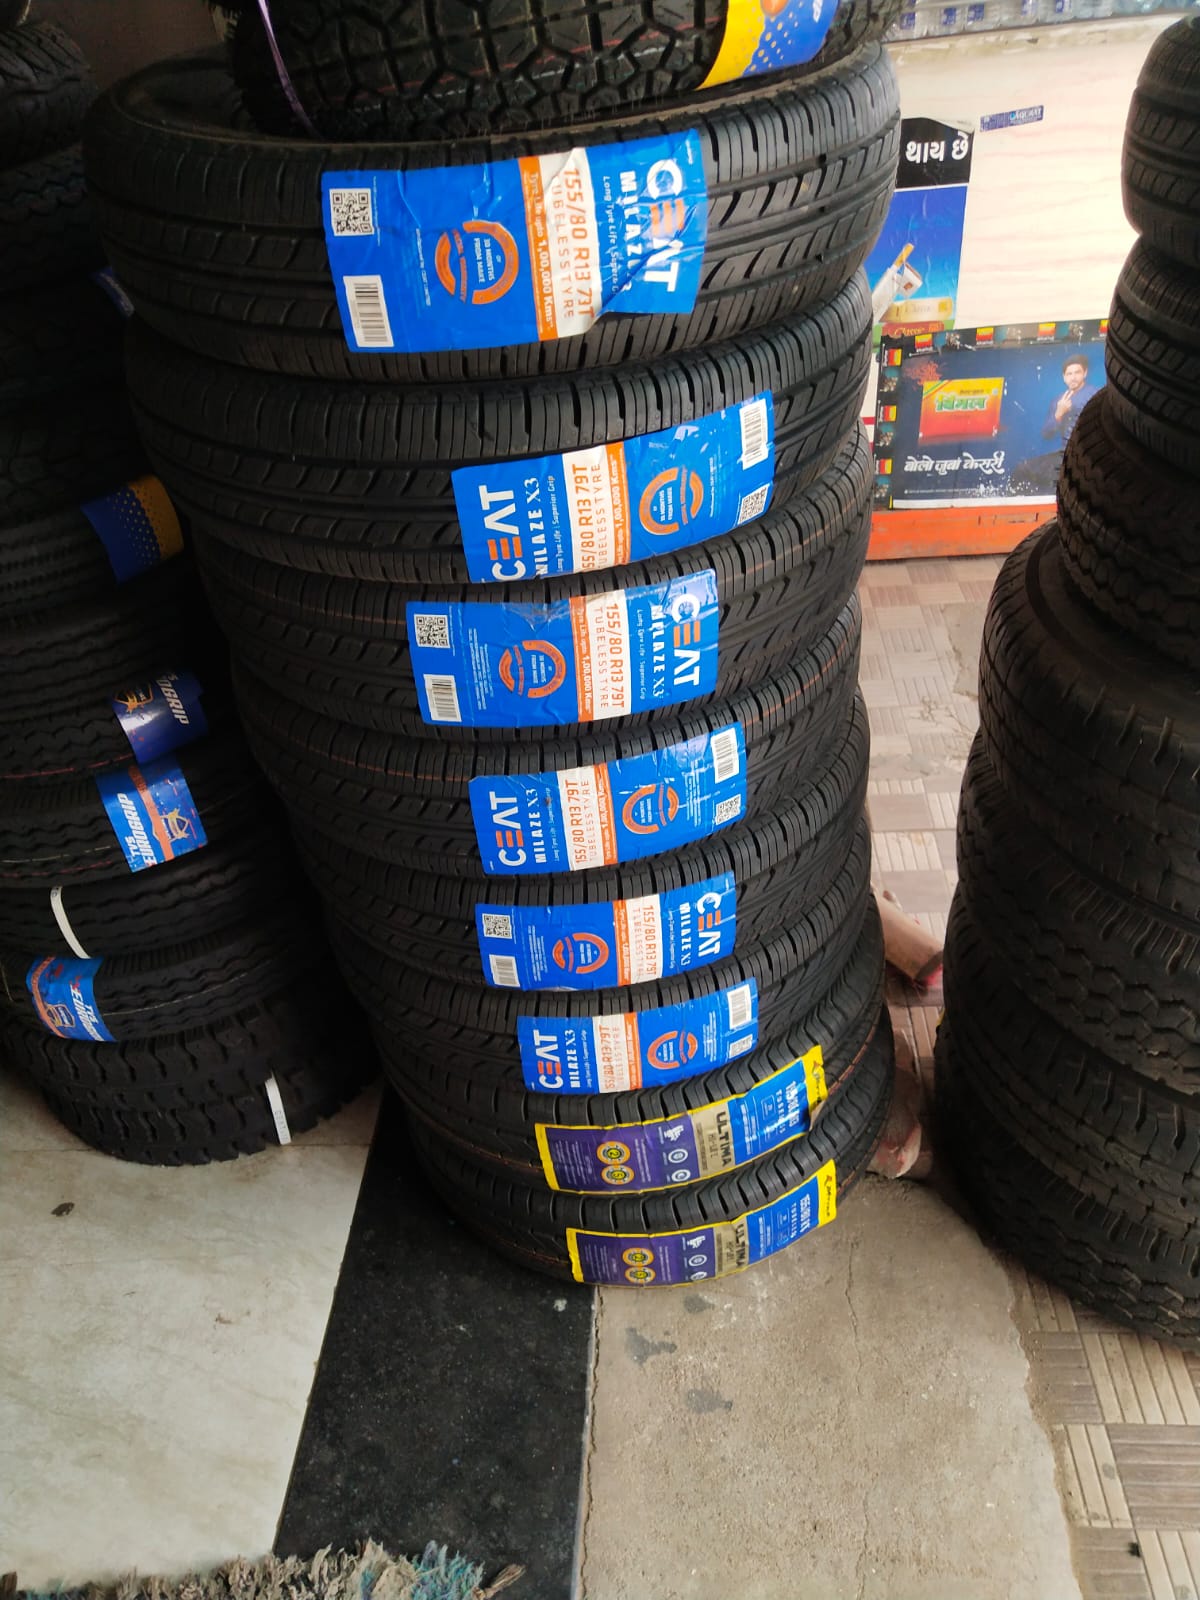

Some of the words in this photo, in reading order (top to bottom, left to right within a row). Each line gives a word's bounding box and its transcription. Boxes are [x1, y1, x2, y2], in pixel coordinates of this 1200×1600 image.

[905, 140, 945, 164] થાય
[951, 132, 969, 161] છે
[563, 168, 589, 241] 155/80
[537, 240, 553, 293] 1,00,000
[573, 246, 591, 281] R13
[572, 463, 589, 494] 79T
[903, 455, 935, 472] बोलो
[962, 450, 1005, 475] केसरी
[524, 477, 541, 504] X3
[591, 463, 604, 505] TYRE
[577, 500, 594, 527] R13
[478, 484, 526, 581] CEAT
[580, 531, 598, 571] 55/80
[595, 605, 607, 675] TUBELESS
[606, 603, 623, 655] 155/80
[671, 593, 700, 686] CEAT
[609, 658, 624, 680] R13
[599, 679, 609, 709] TYRE
[611, 684, 625, 708] 79T
[652, 676, 665, 697] X3
[526, 788, 541, 807] X3
[564, 779, 579, 804] 79T
[580, 780, 592, 811] TYRE
[489, 791, 526, 867] CEAT
[569, 805, 584, 828] R13
[124, 836, 140, 859] TVS
[529, 811, 547, 864] MILAZE
[572, 829, 587, 864] 155/80
[642, 905, 656, 941] 155/80
[678, 902, 692, 952] MILAZE
[696, 892, 722, 957] CEAT
[645, 943, 657, 960] R13
[680, 952, 692, 967] X3
[564, 1029, 577, 1047] X3
[533, 1029, 564, 1089] CEAT
[603, 1064, 616, 1090] 55/80
[716, 1111, 732, 1167] ULTIMA
[735, 1223, 746, 1268] ULTIMA
